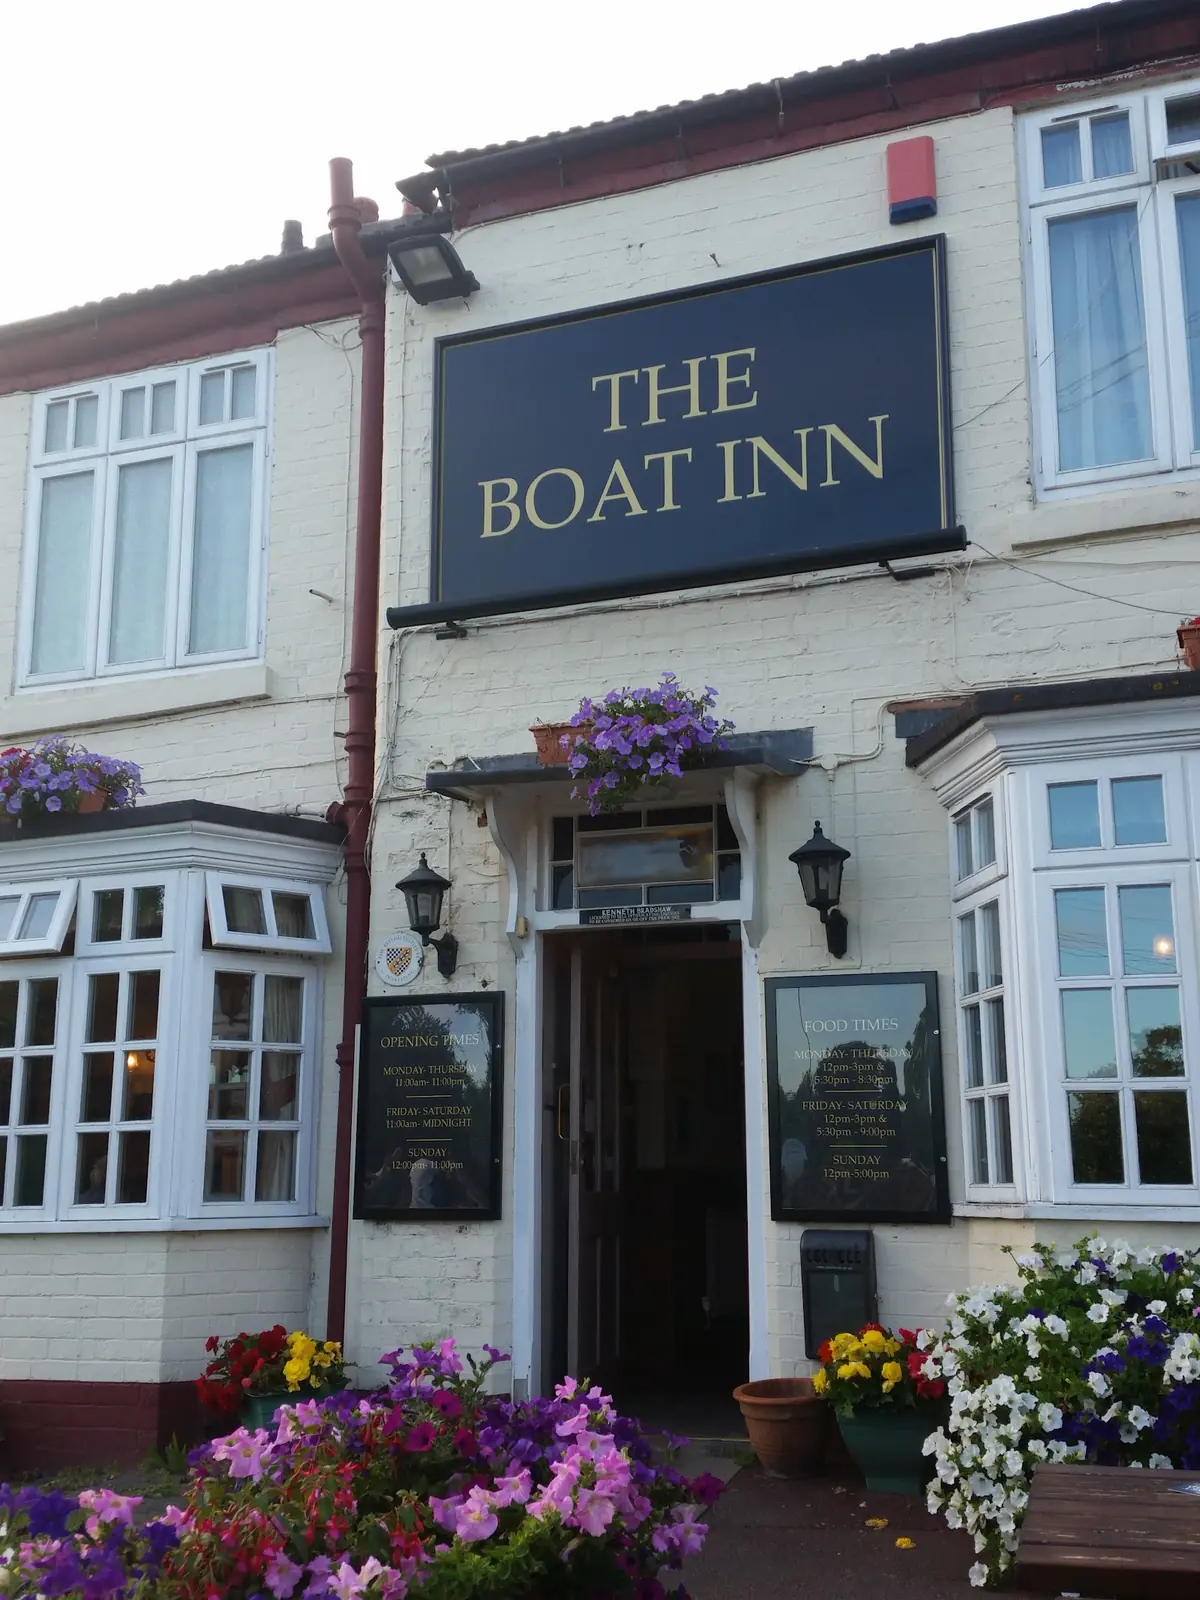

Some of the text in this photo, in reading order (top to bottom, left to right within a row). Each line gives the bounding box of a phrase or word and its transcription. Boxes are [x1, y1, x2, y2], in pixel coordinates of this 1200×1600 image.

[592, 347, 758, 432] THE
[477, 414, 890, 539] BOAT INN
[601, 908, 635, 917] KENNETH
[636, 906, 672, 914] BRADSHAW
[804, 1018, 899, 1032] FOOD TIMES
[380, 1033, 479, 1048] OPENING TIMES
[850, 1048, 914, 1058] THURSDAY
[428, 1064, 479, 1074] THURSDAY
[823, 1062, 885, 1074] 12pm-3pm &
[432, 1077, 465, 1088] 11:00pm
[814, 1075, 850, 1087] 5:30pm
[858, 1074, 894, 1086] 8:30pm
[422, 1106, 473, 1115] SATURDAY
[847, 1100, 909, 1110] SATURDAY
[422, 1118, 472, 1127] MIDNIGHT
[824, 1114, 887, 1126] 12pm-3pm &
[816, 1127, 852, 1138] 5:30pm
[860, 1127, 896, 1138] 9:00pm
[408, 1148, 447, 1157] SUNDAY
[430, 1160, 464, 1171] 11:00pm
[832, 1155, 881, 1165] SUNDAY
[823, 1168, 890, 1180] 12pm-5:00pm
